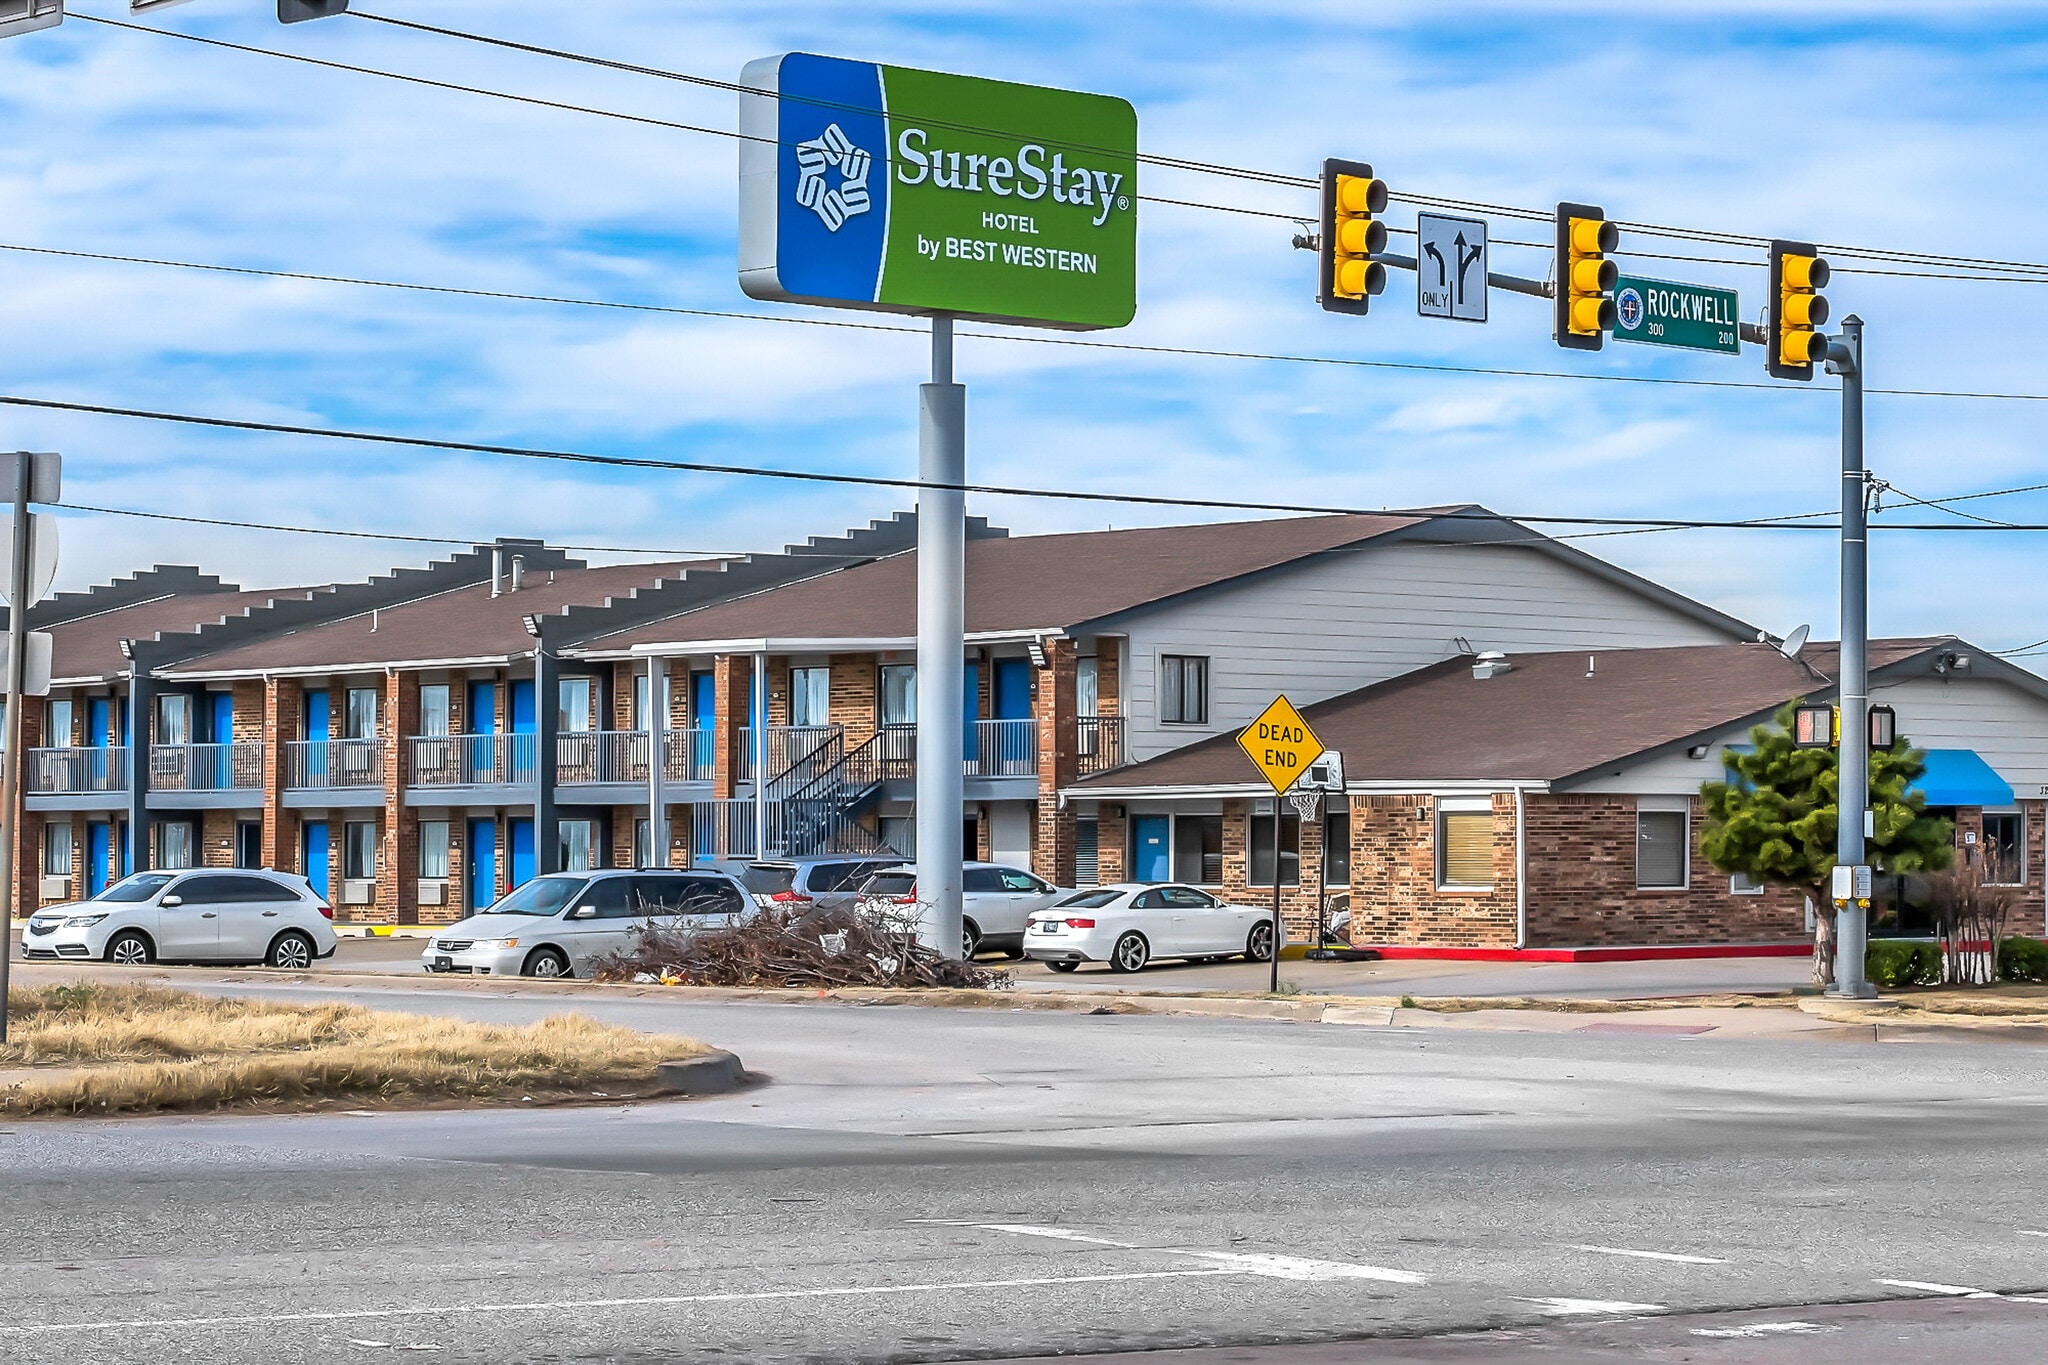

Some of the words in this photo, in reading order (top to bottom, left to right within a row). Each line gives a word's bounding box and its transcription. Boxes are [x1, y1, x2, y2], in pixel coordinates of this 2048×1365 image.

[982, 211, 1039, 234] HOTEL
[917, 234, 941, 260] by
[945, 237, 998, 262] BEST
[1002, 243, 1097, 274] WESTERN
[1422, 291, 1449, 308] ONLY
[1647, 288, 1734, 326] ROCKWELL
[1647, 322, 1664, 337] 300
[1718, 331, 1734, 345] 200
[1259, 723, 1303, 743] DEAD
[1265, 749, 1297, 768] END
